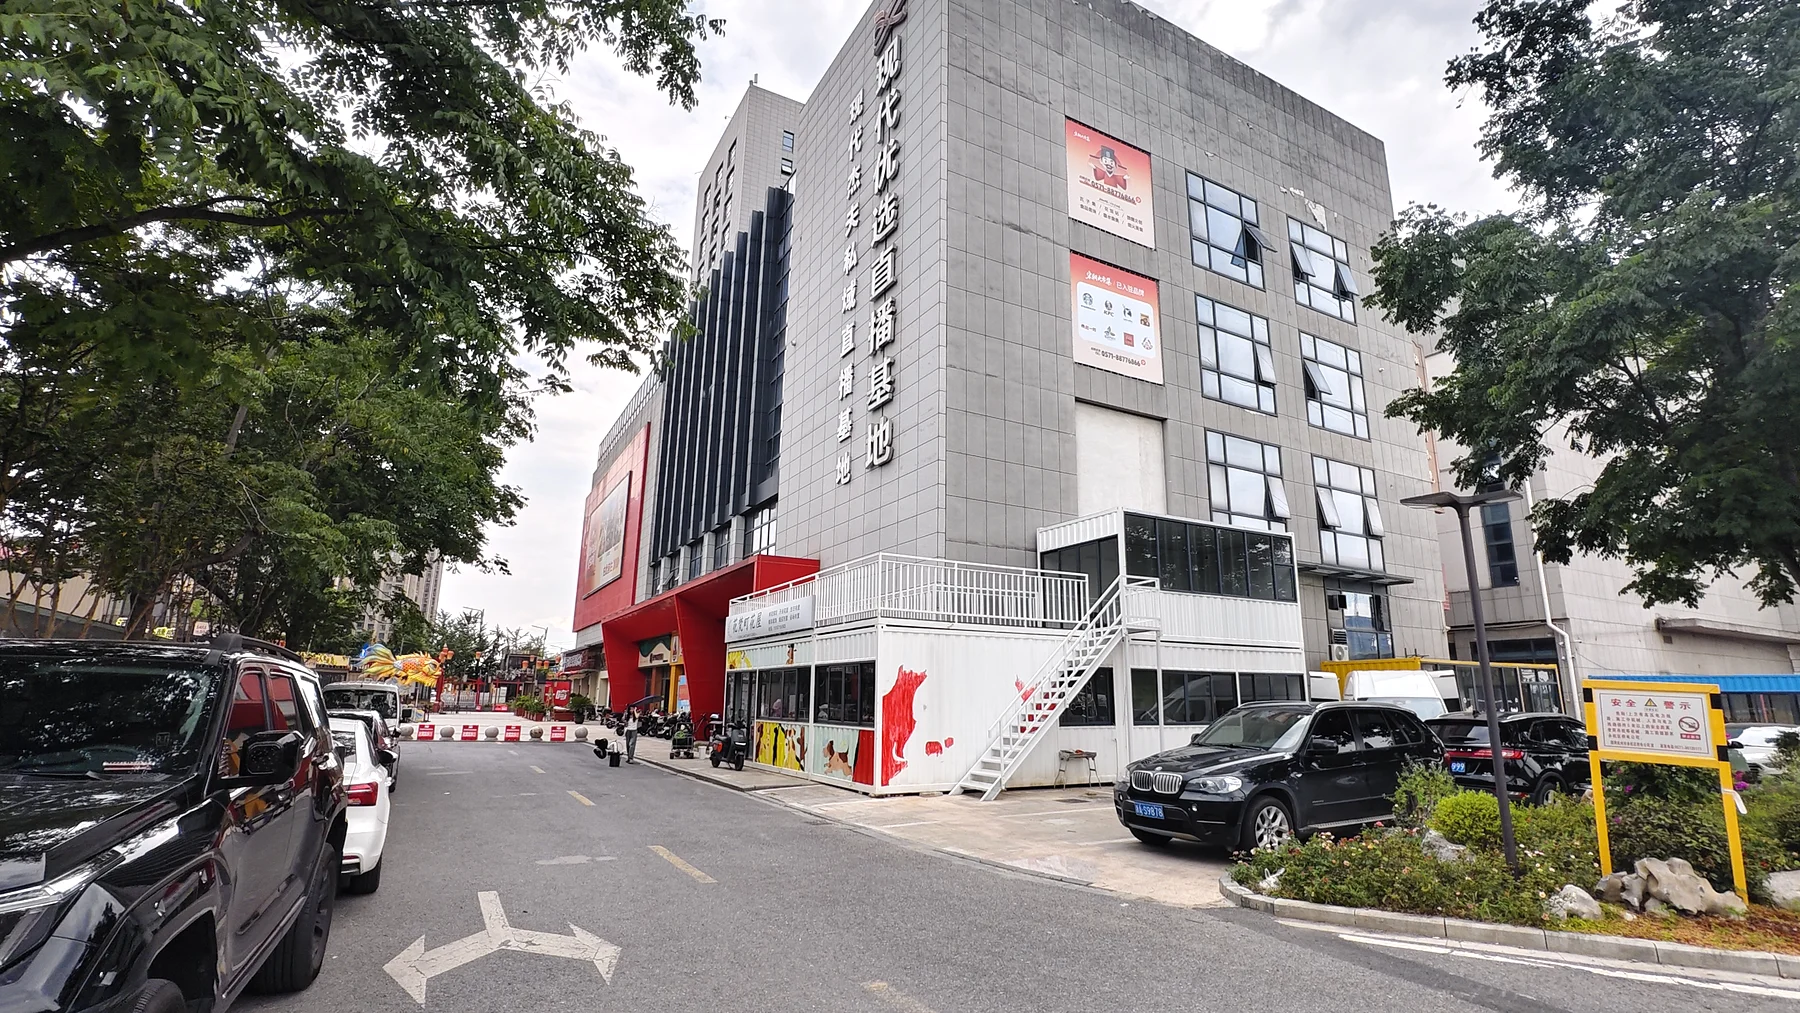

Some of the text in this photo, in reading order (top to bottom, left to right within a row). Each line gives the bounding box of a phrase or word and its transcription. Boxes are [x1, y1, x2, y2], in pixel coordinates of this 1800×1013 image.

[865, 35, 903, 470] 现代优选直播基地
[1103, 309, 1115, 317] KFC
[1611, 698, 1636, 708] 安全
[1663, 700, 1692, 710] 警示
